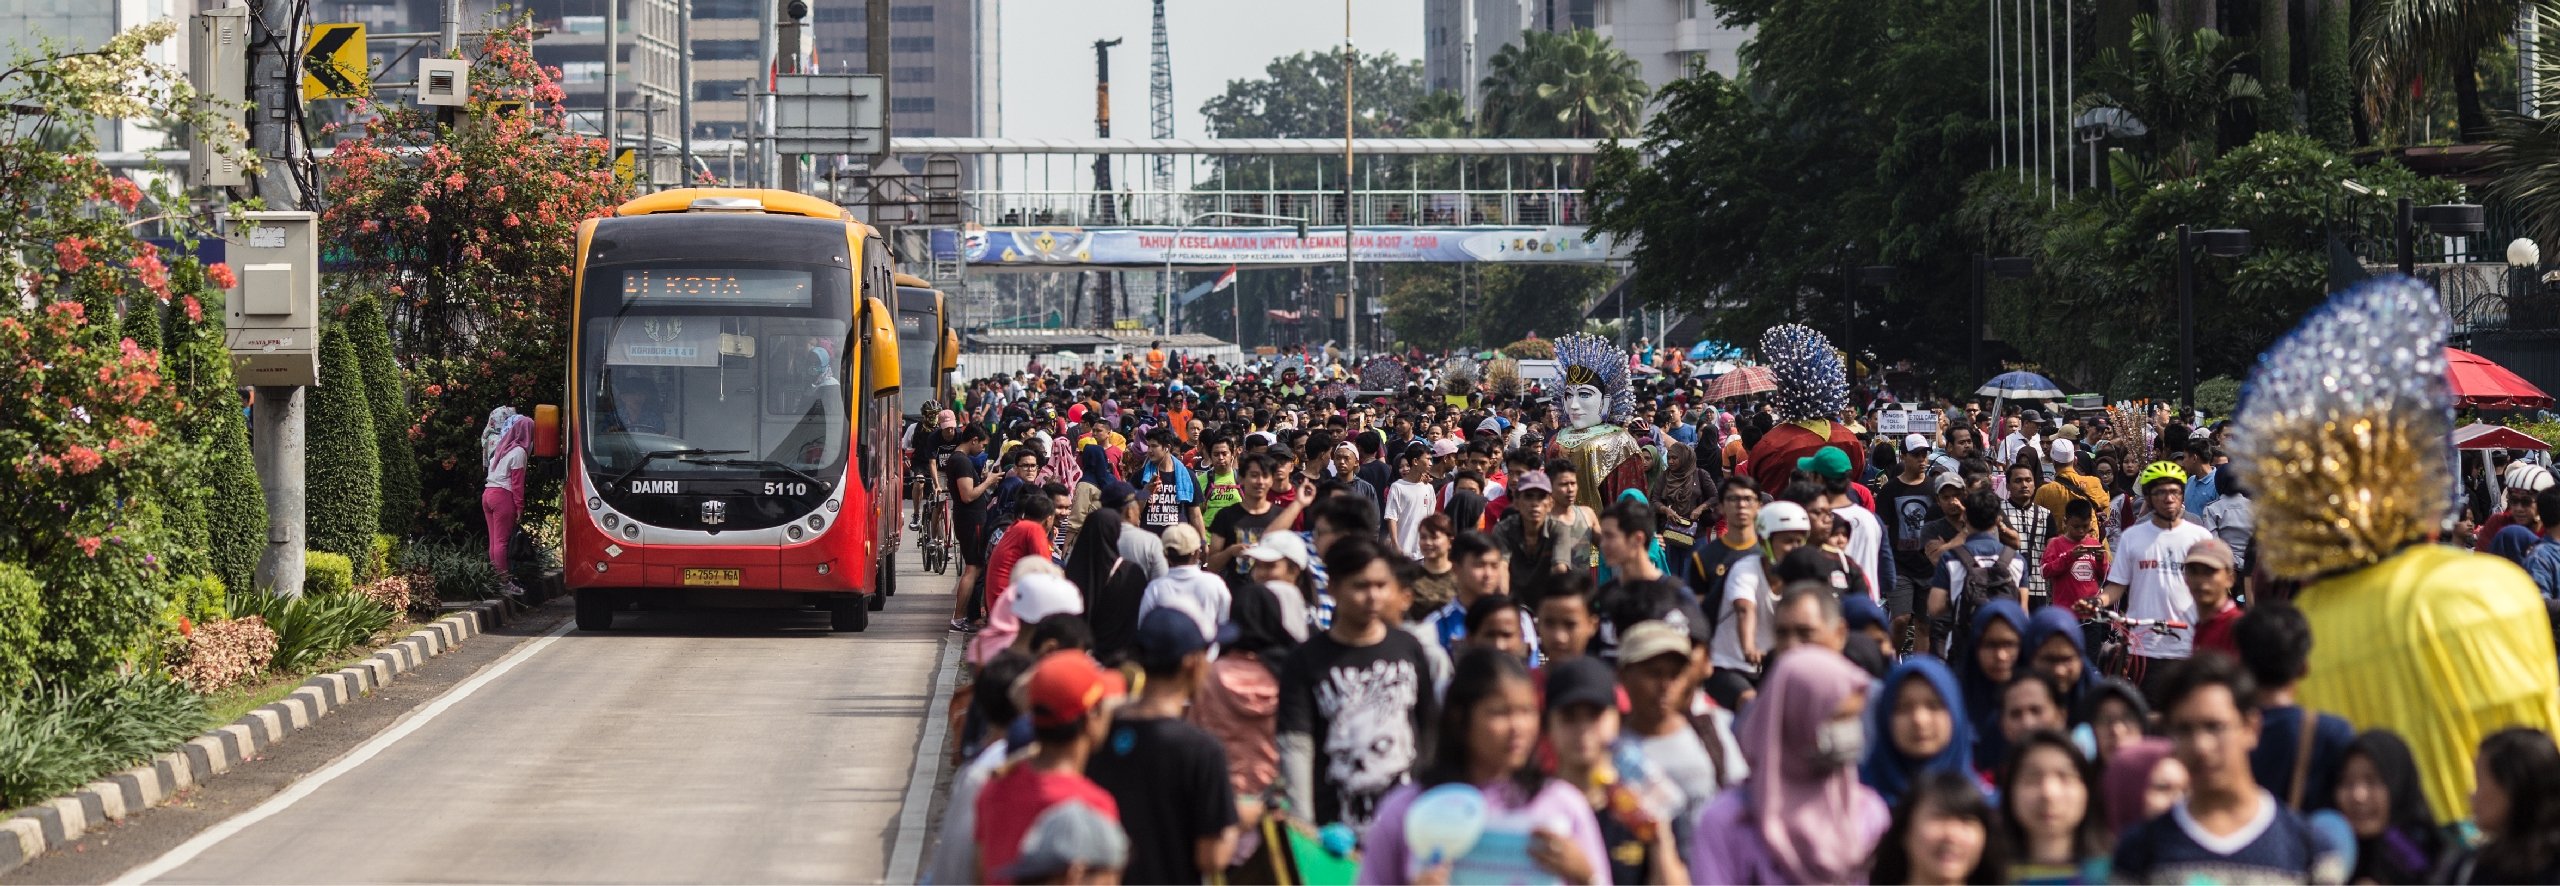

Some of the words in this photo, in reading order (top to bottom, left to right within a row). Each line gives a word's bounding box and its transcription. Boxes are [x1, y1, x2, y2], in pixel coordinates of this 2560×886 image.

[1139, 236, 1175, 249] TAHUN
[1180, 236, 1258, 249] KESELAMATAN
[1261, 236, 1298, 249] UNTUK
[1377, 236, 1402, 249] 2017
[666, 277, 741, 294] KOTA
[632, 480, 678, 494] DAMRI
[764, 482, 807, 495] 5110
[1148, 493, 1179, 504] SPEAK
[1162, 505, 1179, 513] WISE
[1146, 513, 1179, 522] LISTENS
